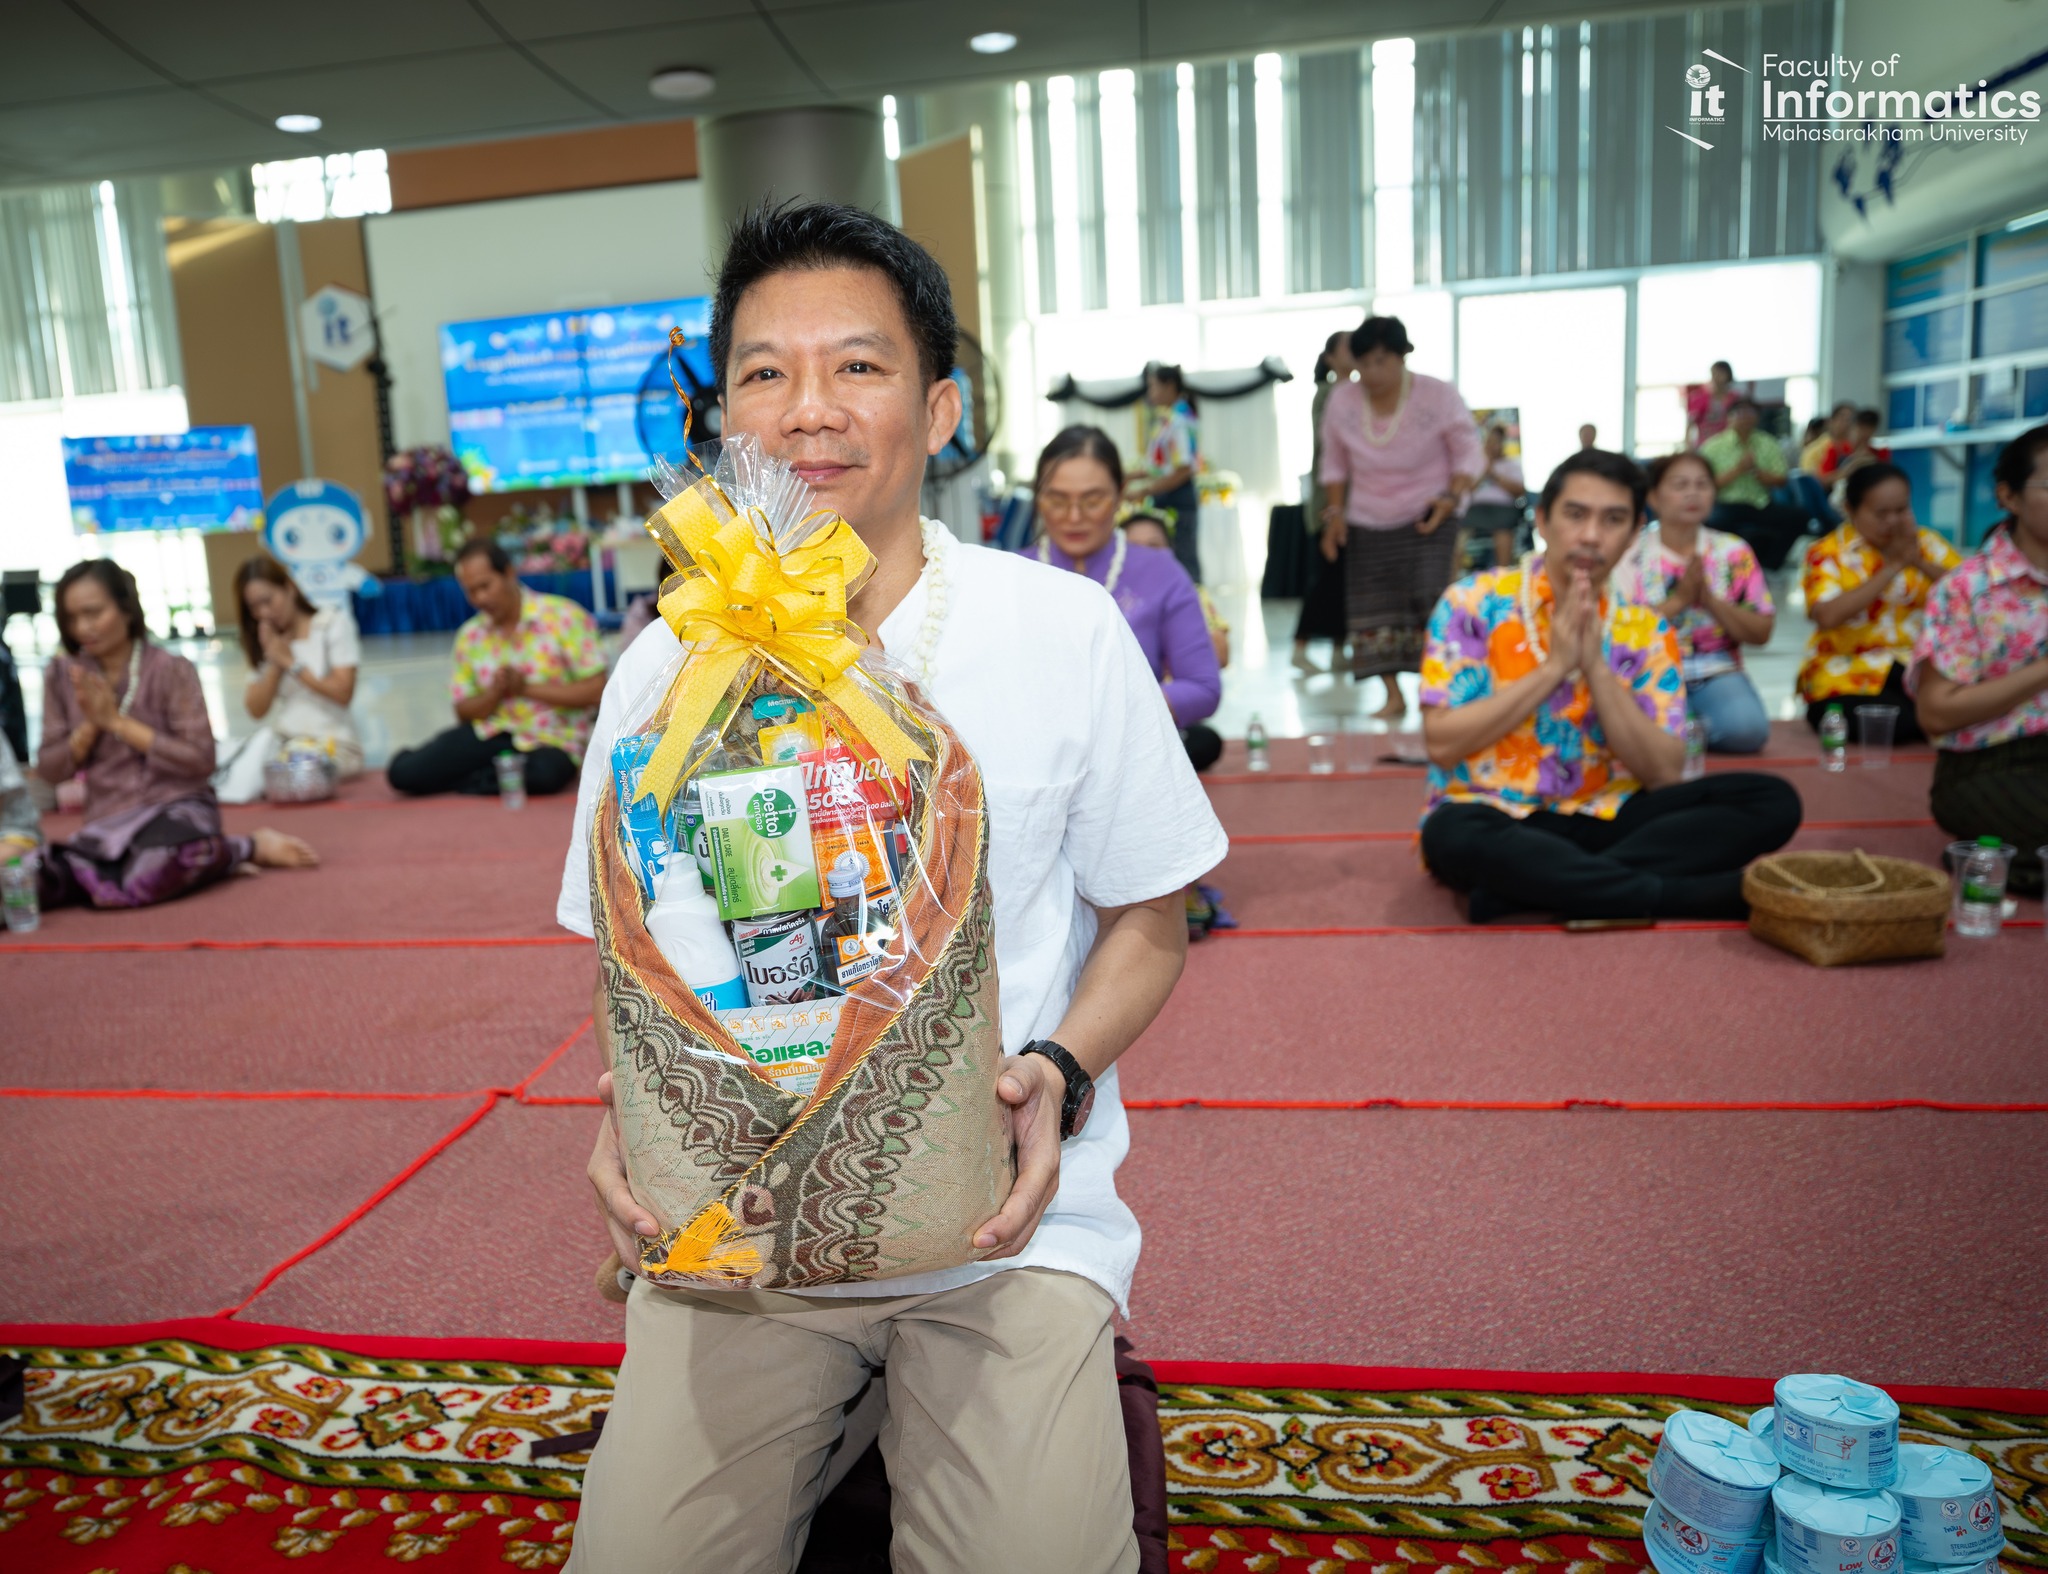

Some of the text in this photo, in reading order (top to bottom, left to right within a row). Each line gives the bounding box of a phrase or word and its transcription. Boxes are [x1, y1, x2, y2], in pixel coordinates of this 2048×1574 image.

[761, 788, 782, 837] Dettol
[721, 827, 733, 858] DAILY CARE
[744, 946, 816, 986] เบอร์ดี้
[740, 1032, 836, 1064] อแยล-
[1950, 1541, 1978, 1550] STERILIZED
